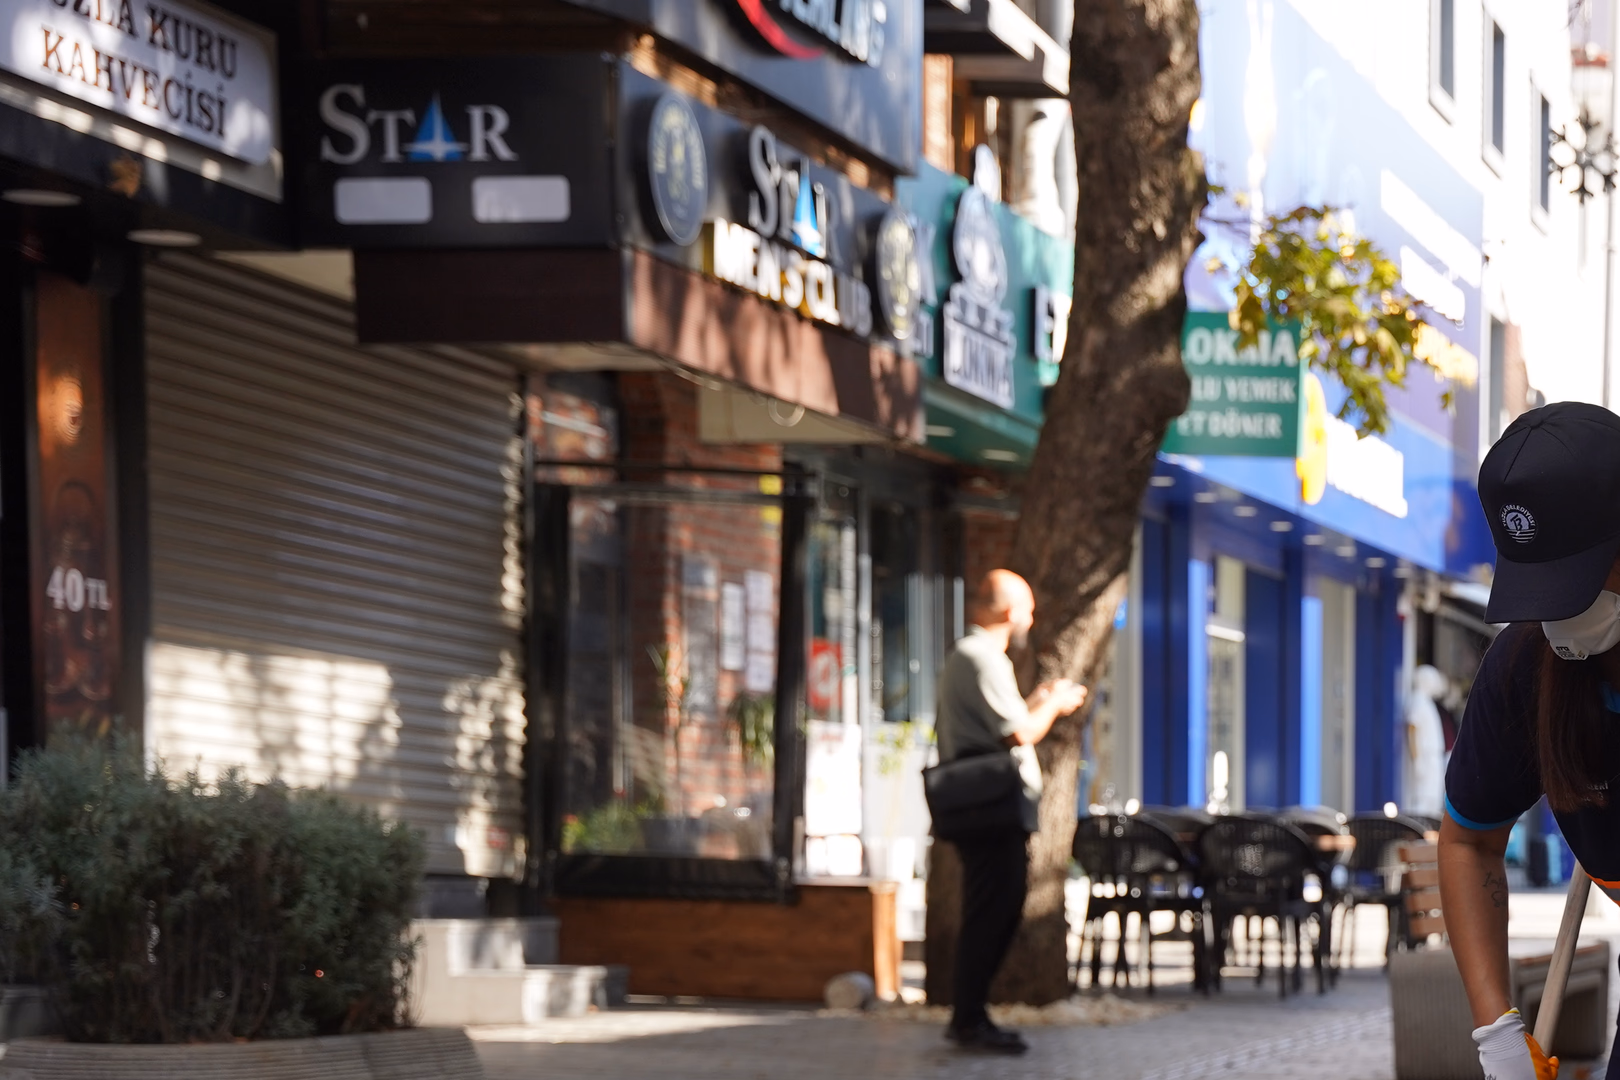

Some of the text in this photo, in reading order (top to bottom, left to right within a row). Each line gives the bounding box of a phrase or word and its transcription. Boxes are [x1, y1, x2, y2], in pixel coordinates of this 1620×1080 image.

[148, 5, 237, 80] KURU
[41, 25, 227, 137] KAHVECİSİ
[1182, 326, 1298, 367] OKMA
